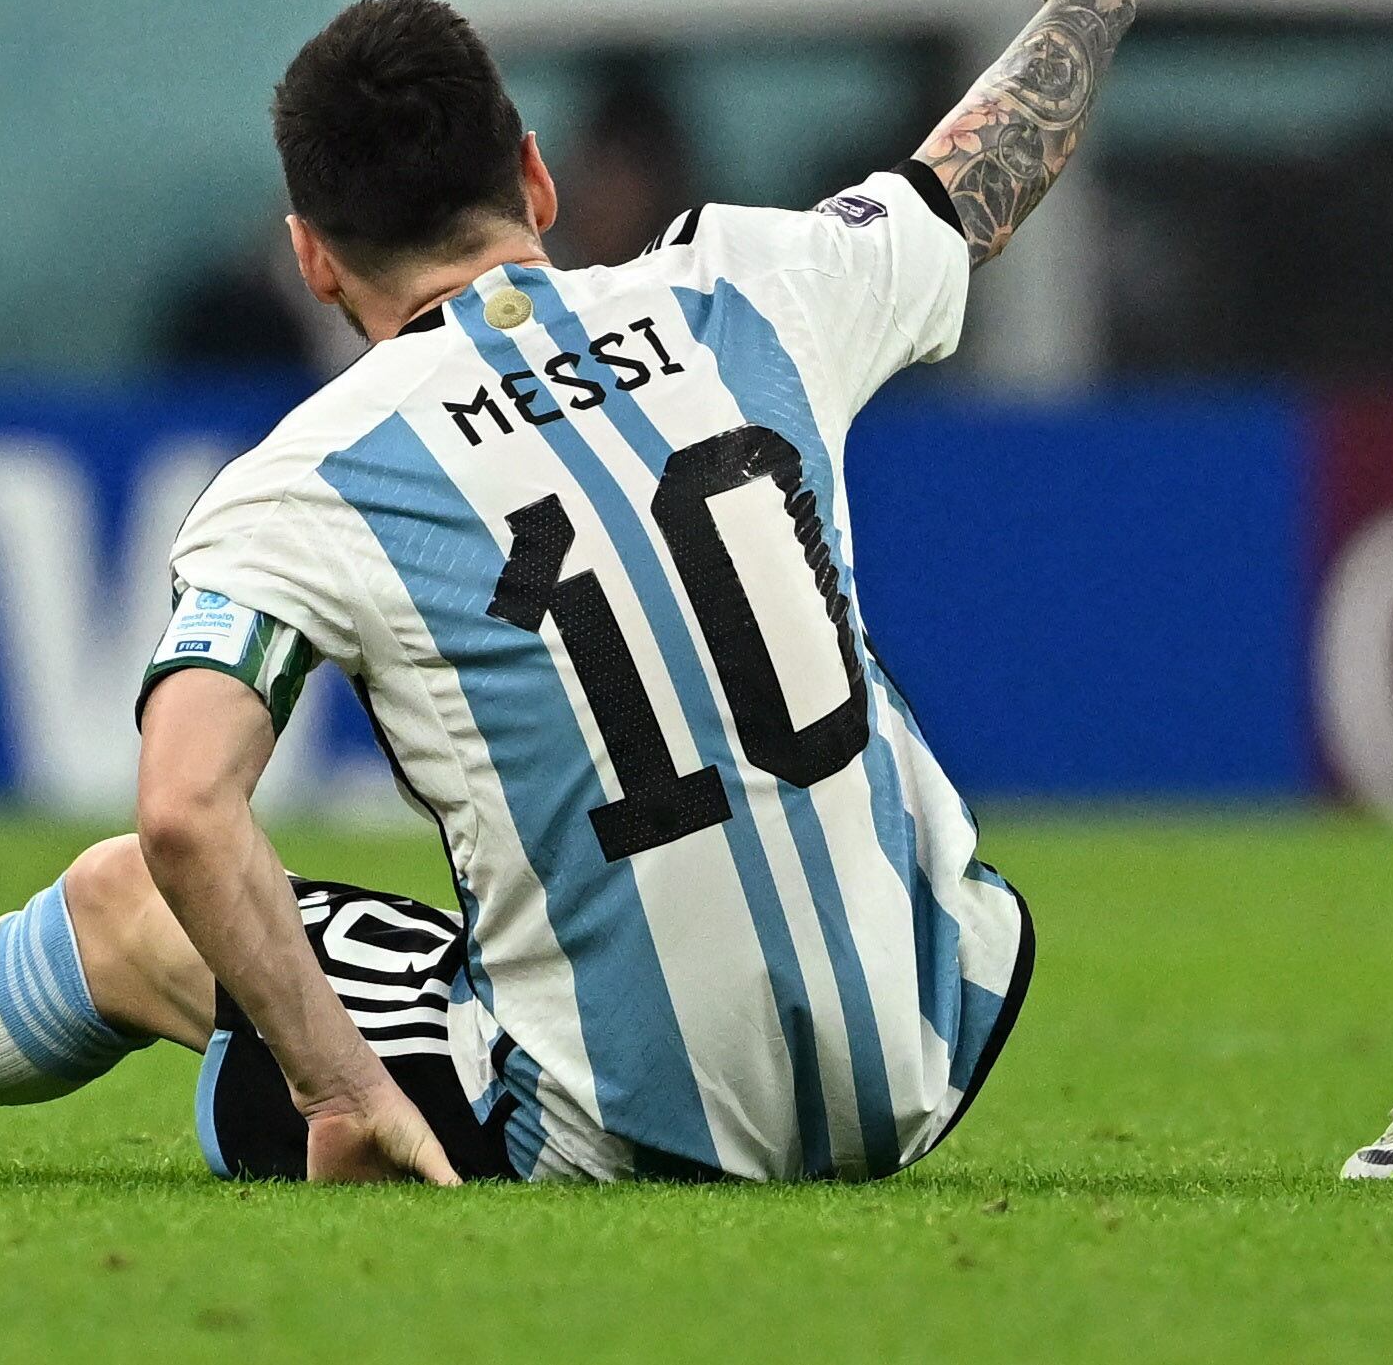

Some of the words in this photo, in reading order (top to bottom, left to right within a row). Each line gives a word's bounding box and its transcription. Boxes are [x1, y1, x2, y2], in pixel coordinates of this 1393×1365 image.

[442, 317, 685, 447] MESSI
[178, 641, 205, 651] FIFA
[486, 422, 870, 864] 10
